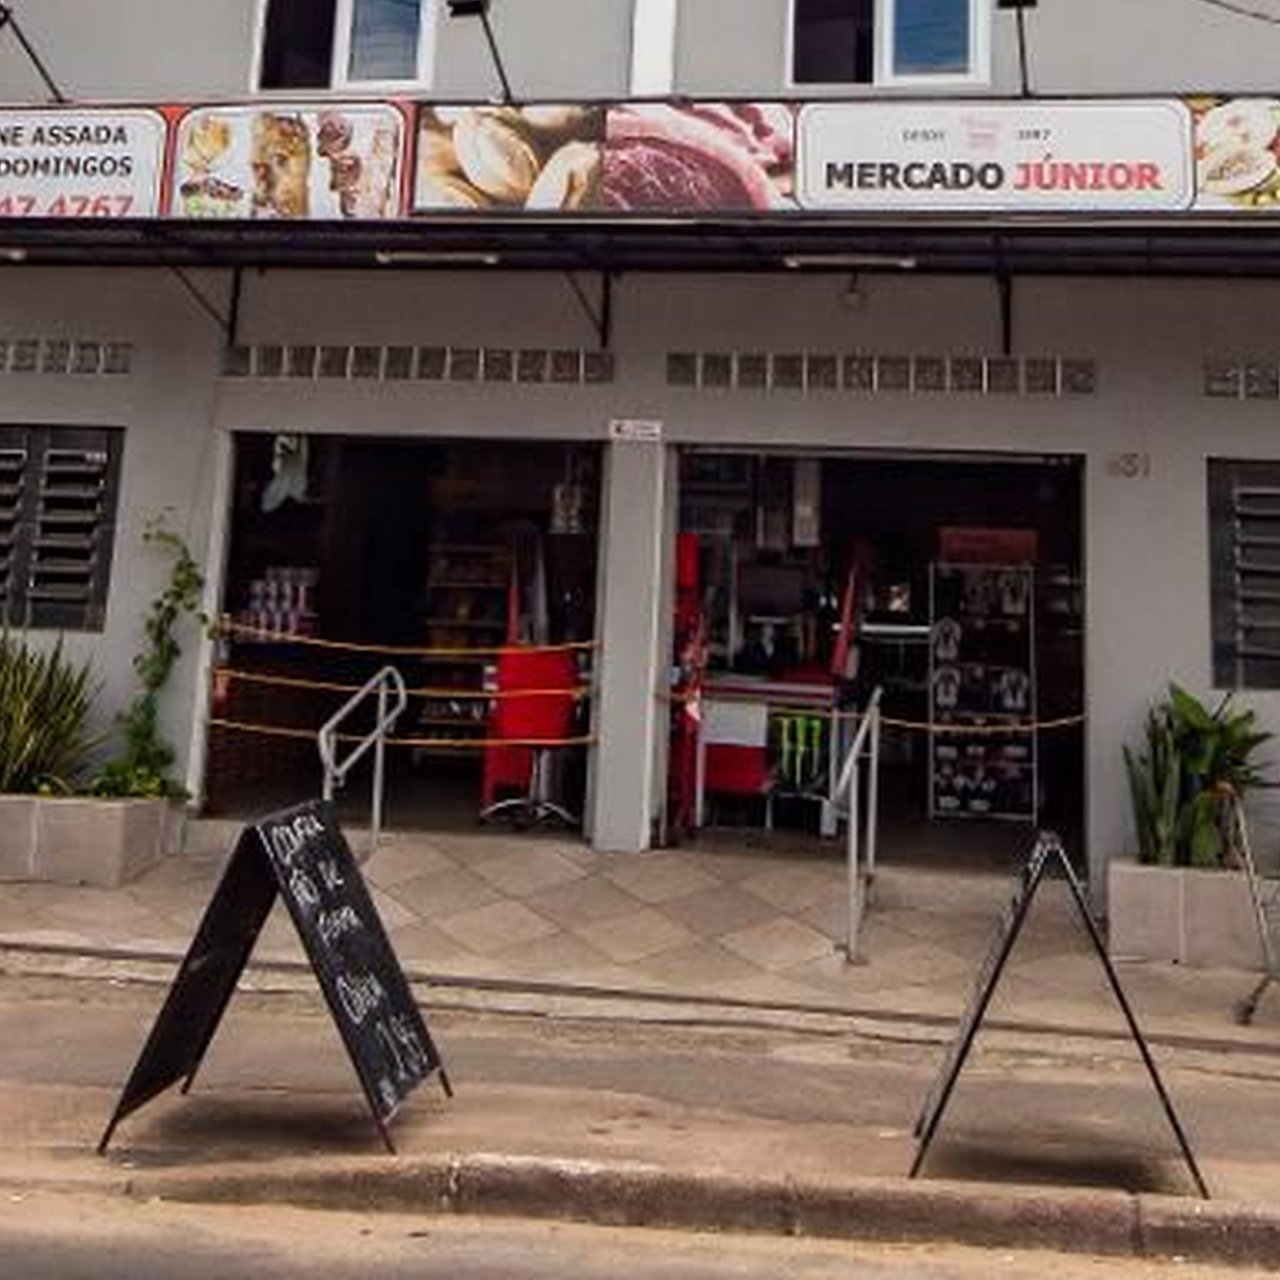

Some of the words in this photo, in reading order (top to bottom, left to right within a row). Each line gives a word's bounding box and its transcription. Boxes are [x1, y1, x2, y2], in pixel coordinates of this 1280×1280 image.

[31, 126, 128, 146] ASSADA
[824, 162, 1005, 190] MERCADO
[1013, 153, 1164, 191] JÚNIOR
